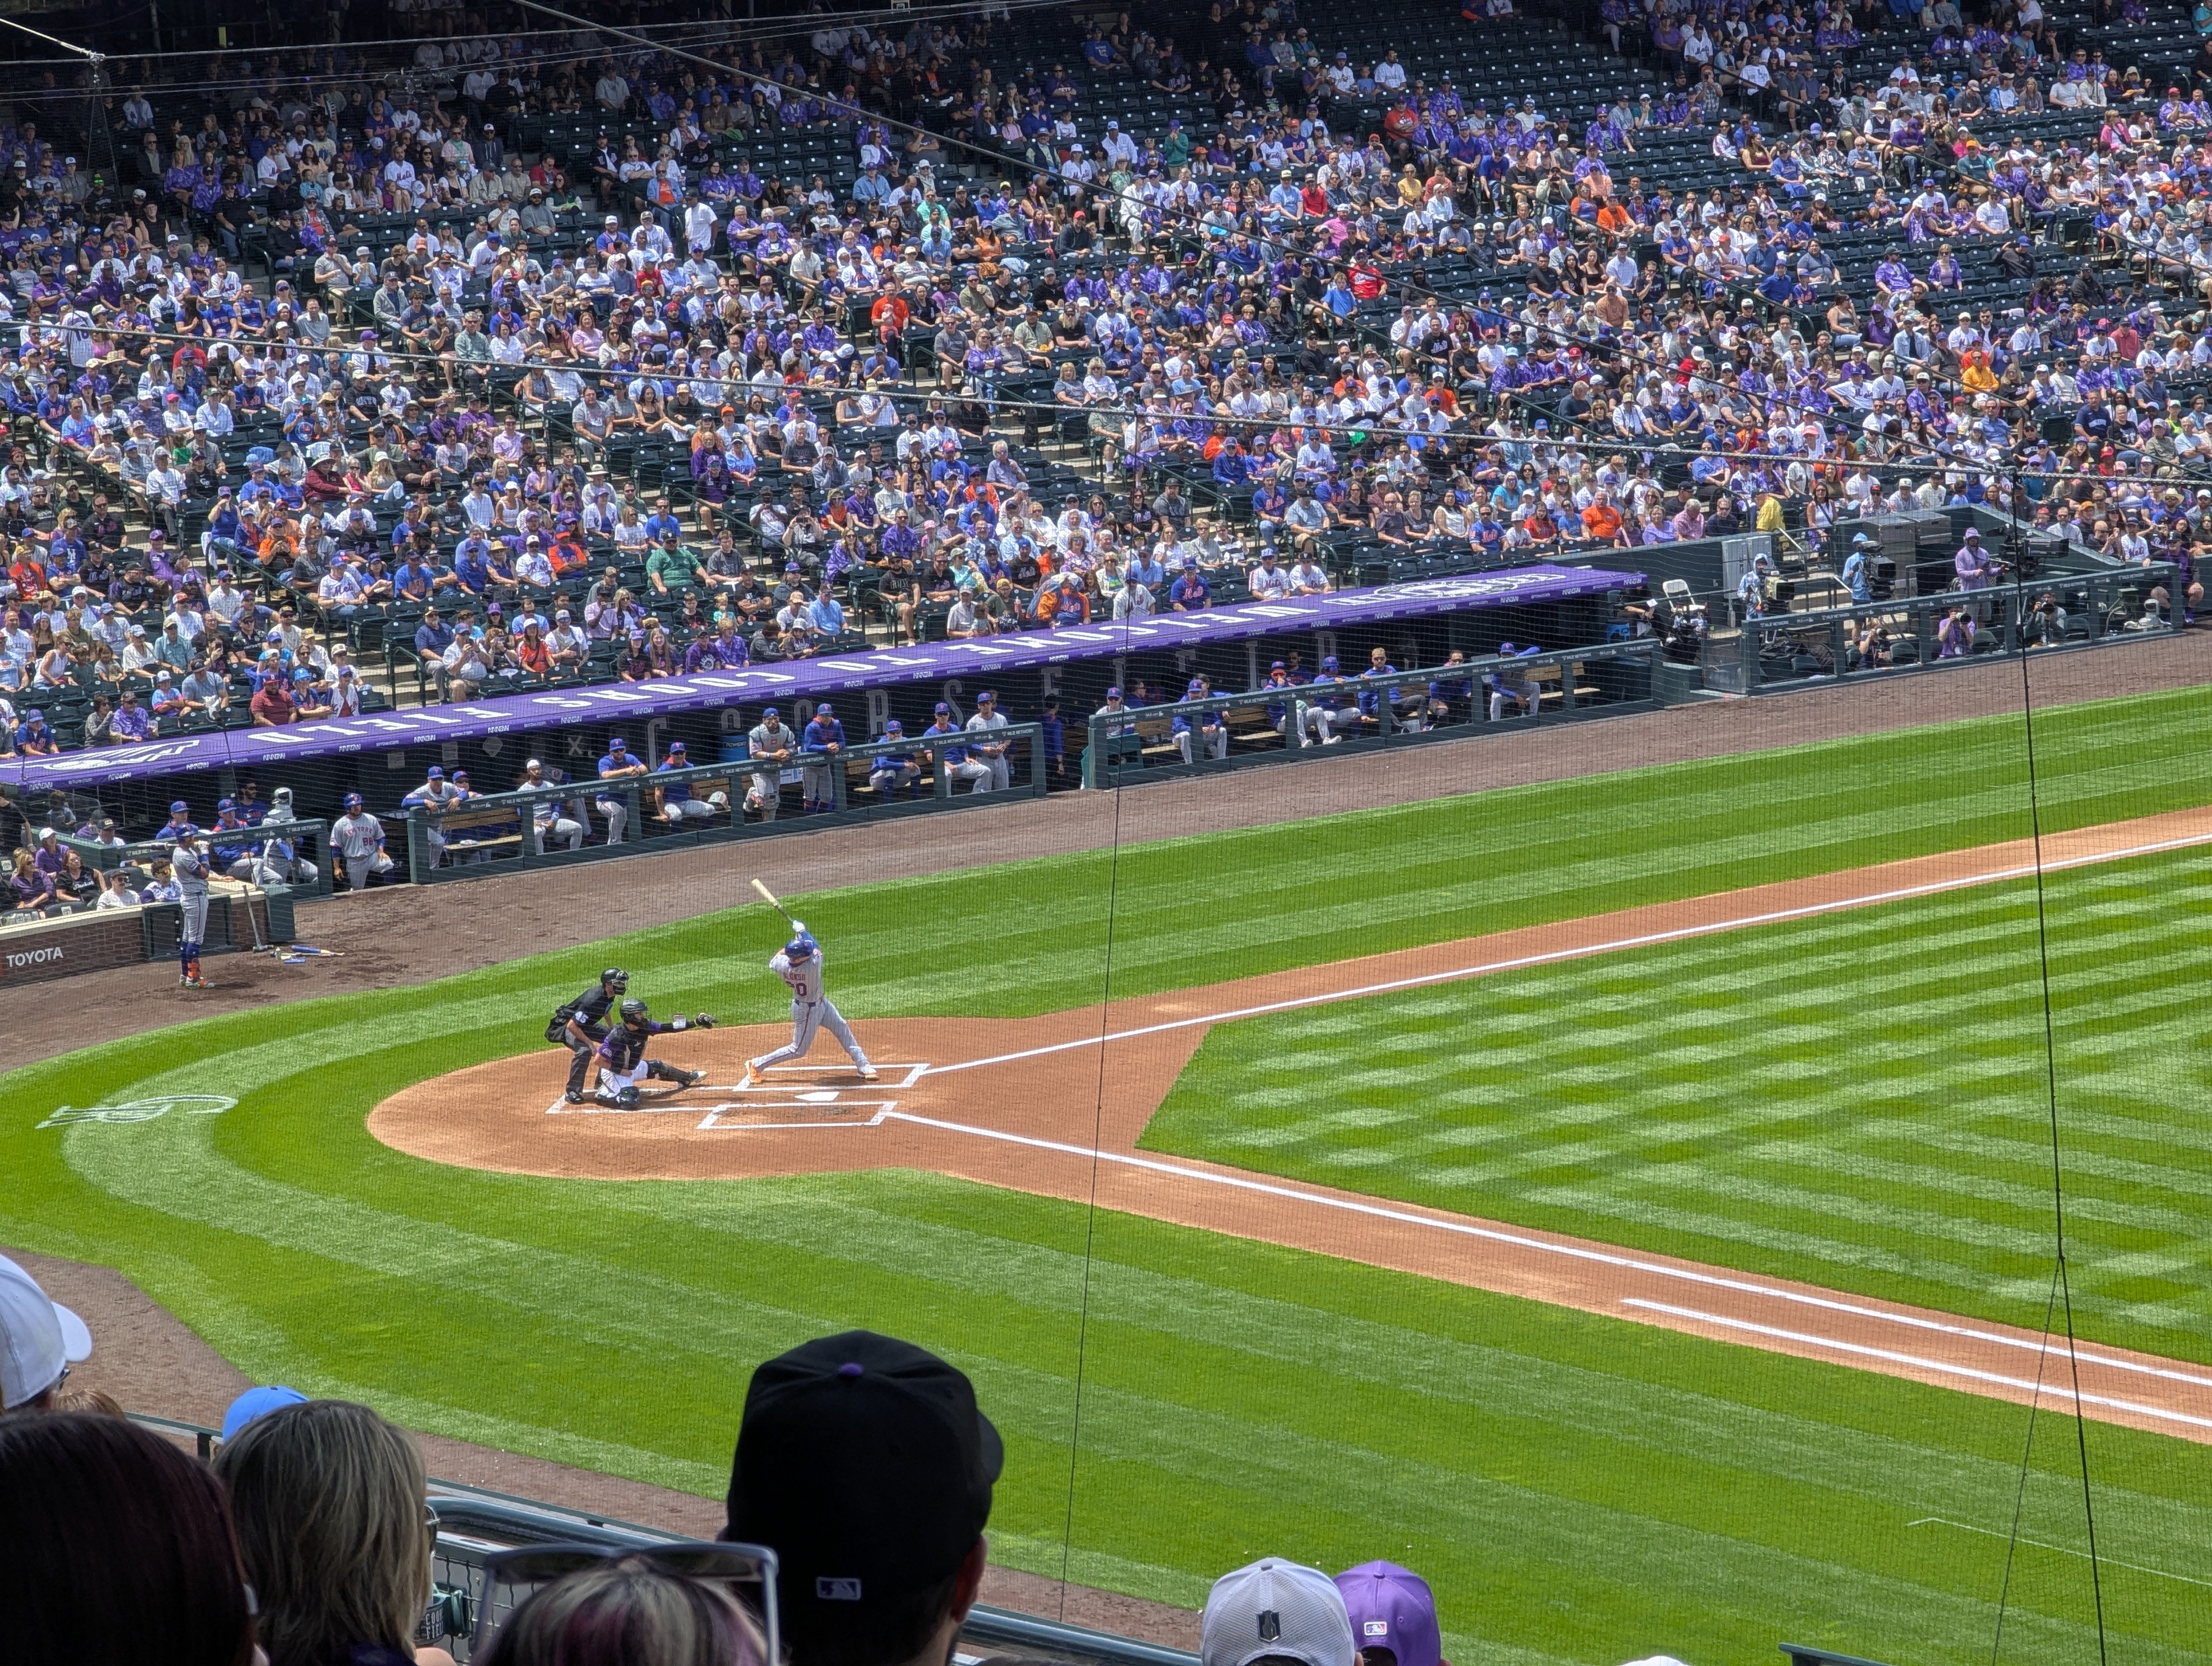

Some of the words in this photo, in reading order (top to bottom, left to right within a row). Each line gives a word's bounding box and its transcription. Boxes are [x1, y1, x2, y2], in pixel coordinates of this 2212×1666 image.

[942, 606, 1321, 655] WELCOME
[532, 672, 796, 708] COORS
[247, 707, 514, 744] FIELD
[6, 947, 63, 967] TOYOTA
[426, 1607, 443, 1626] COOR
